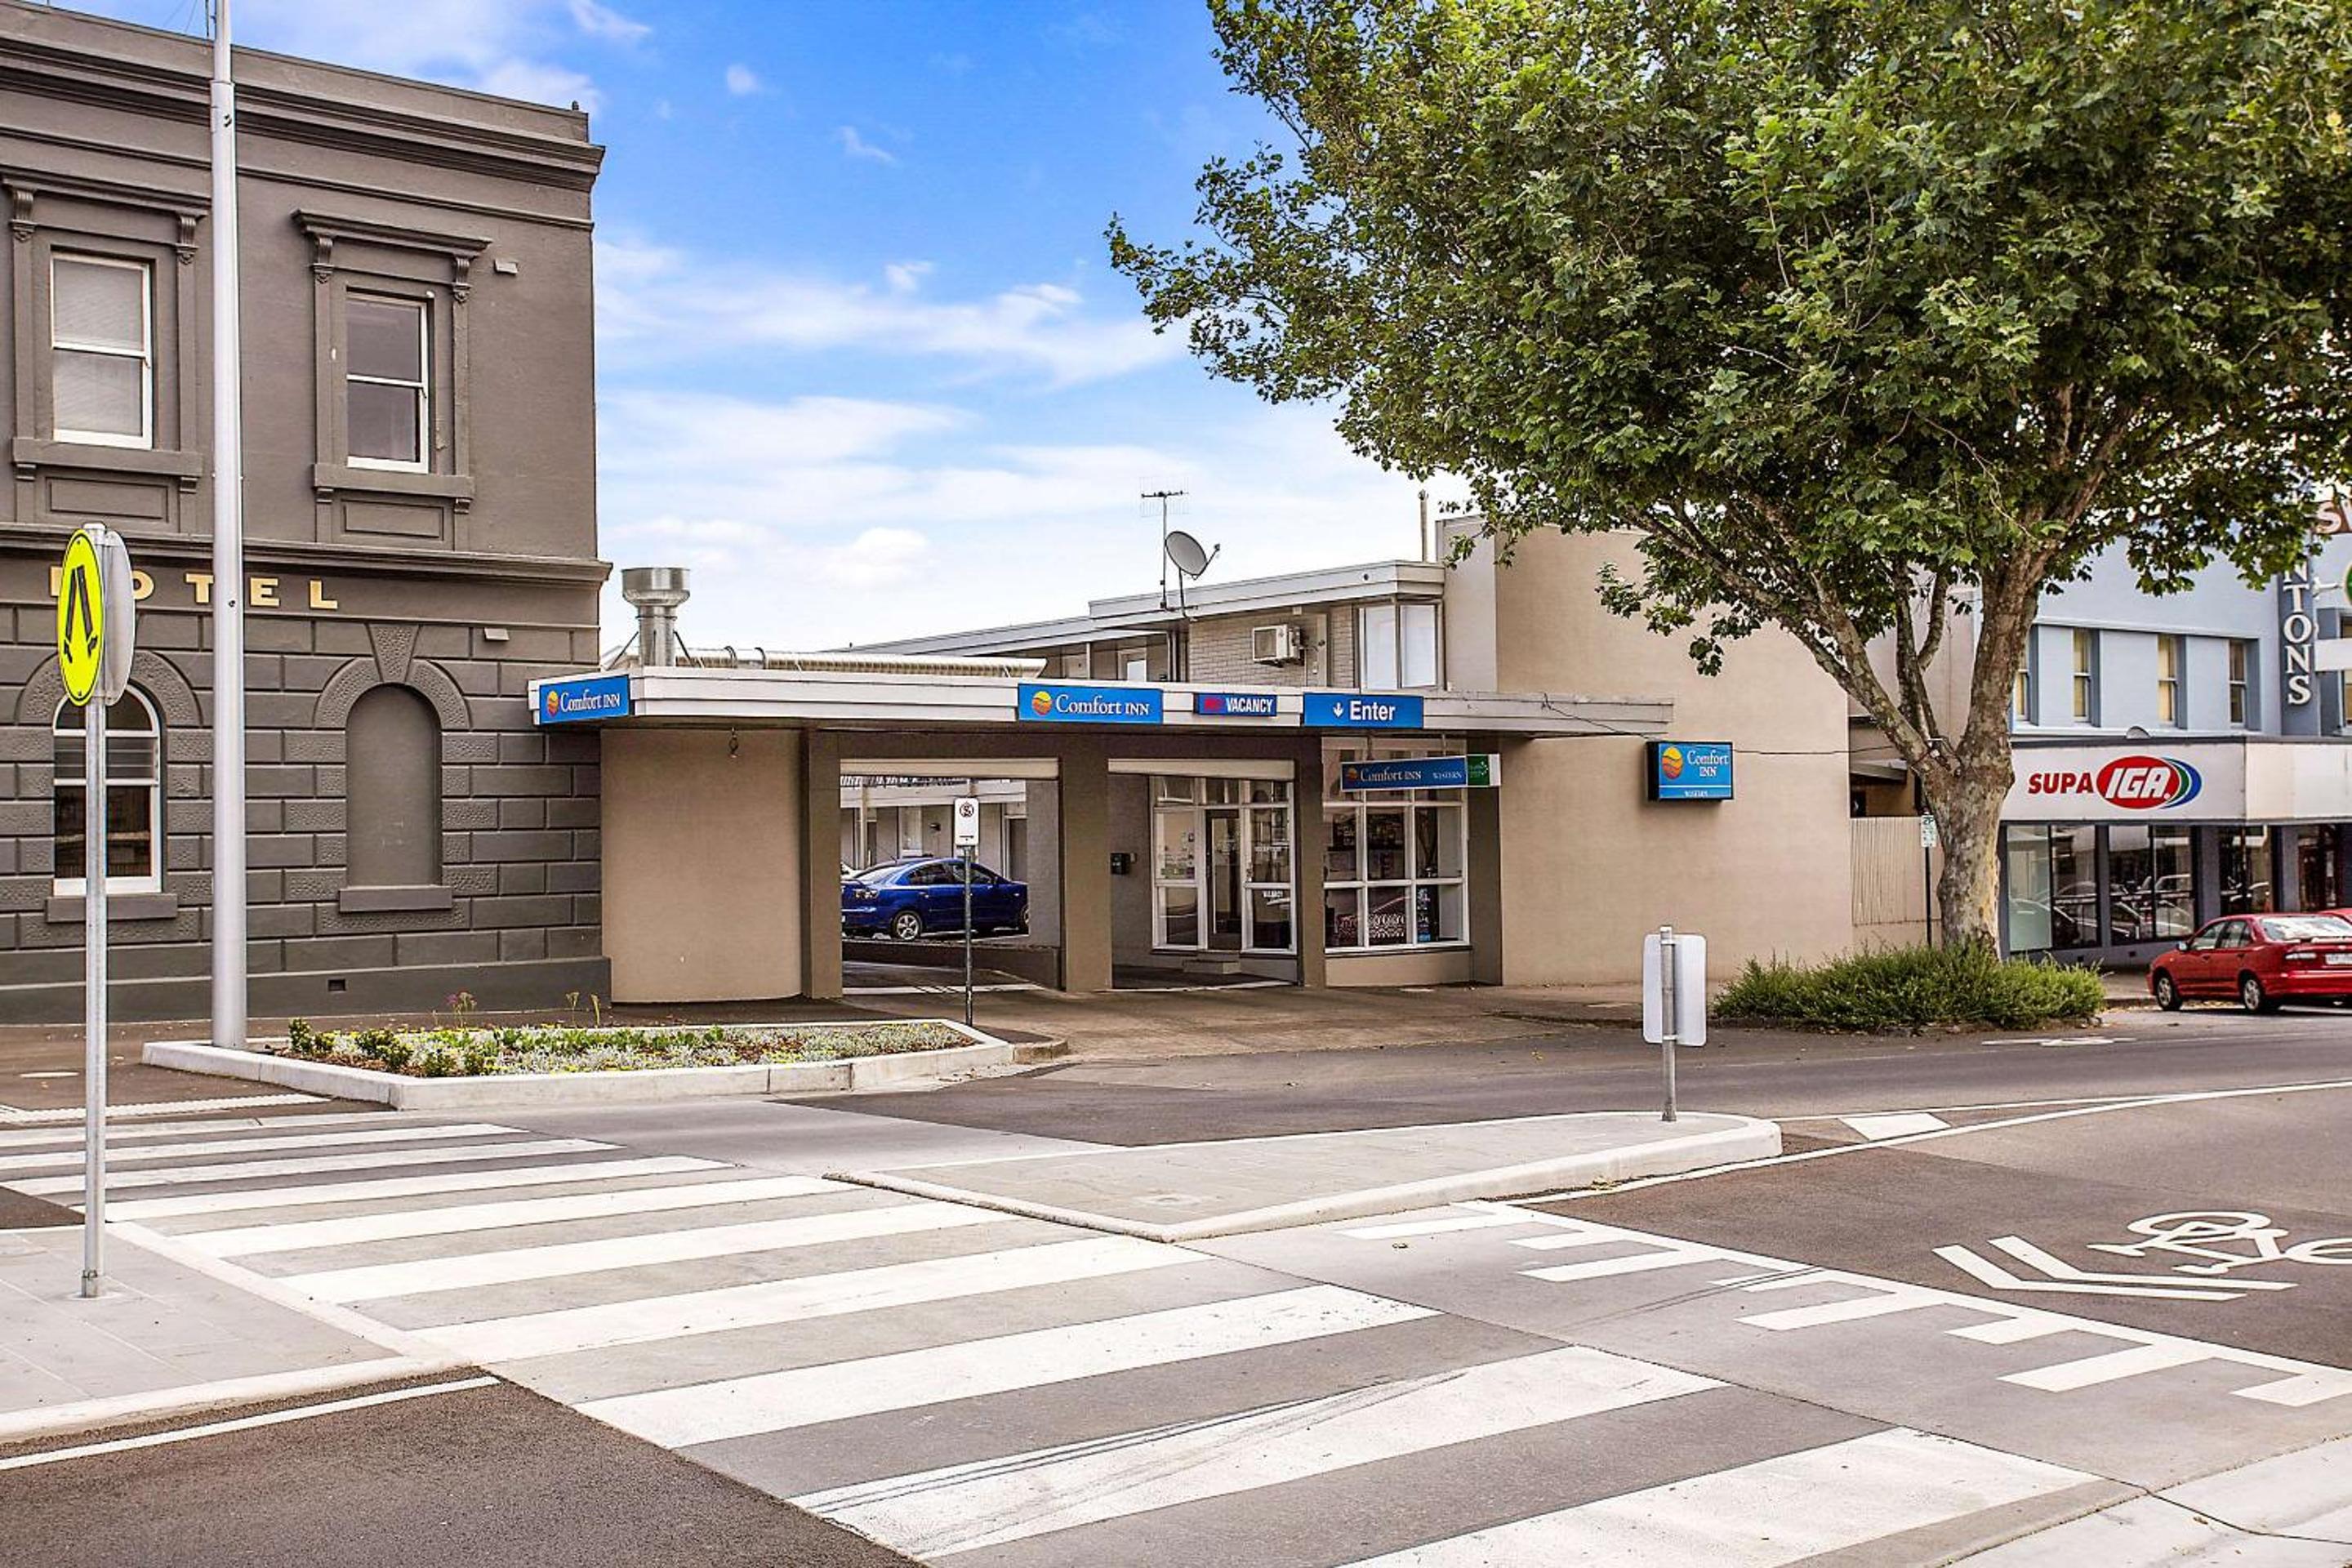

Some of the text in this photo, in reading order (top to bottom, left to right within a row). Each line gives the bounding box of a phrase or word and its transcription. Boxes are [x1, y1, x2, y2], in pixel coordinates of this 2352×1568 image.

[560, 689, 620, 712] Comfort INN
[1056, 693, 1150, 715] Comfort INN
[1225, 697, 1273, 713] VACANCY
[1349, 701, 1396, 721] Enter
[1686, 750, 1730, 766] Comfort
[1360, 765, 1404, 782] Comfort
[2028, 767, 2172, 800] SUPA IGA
